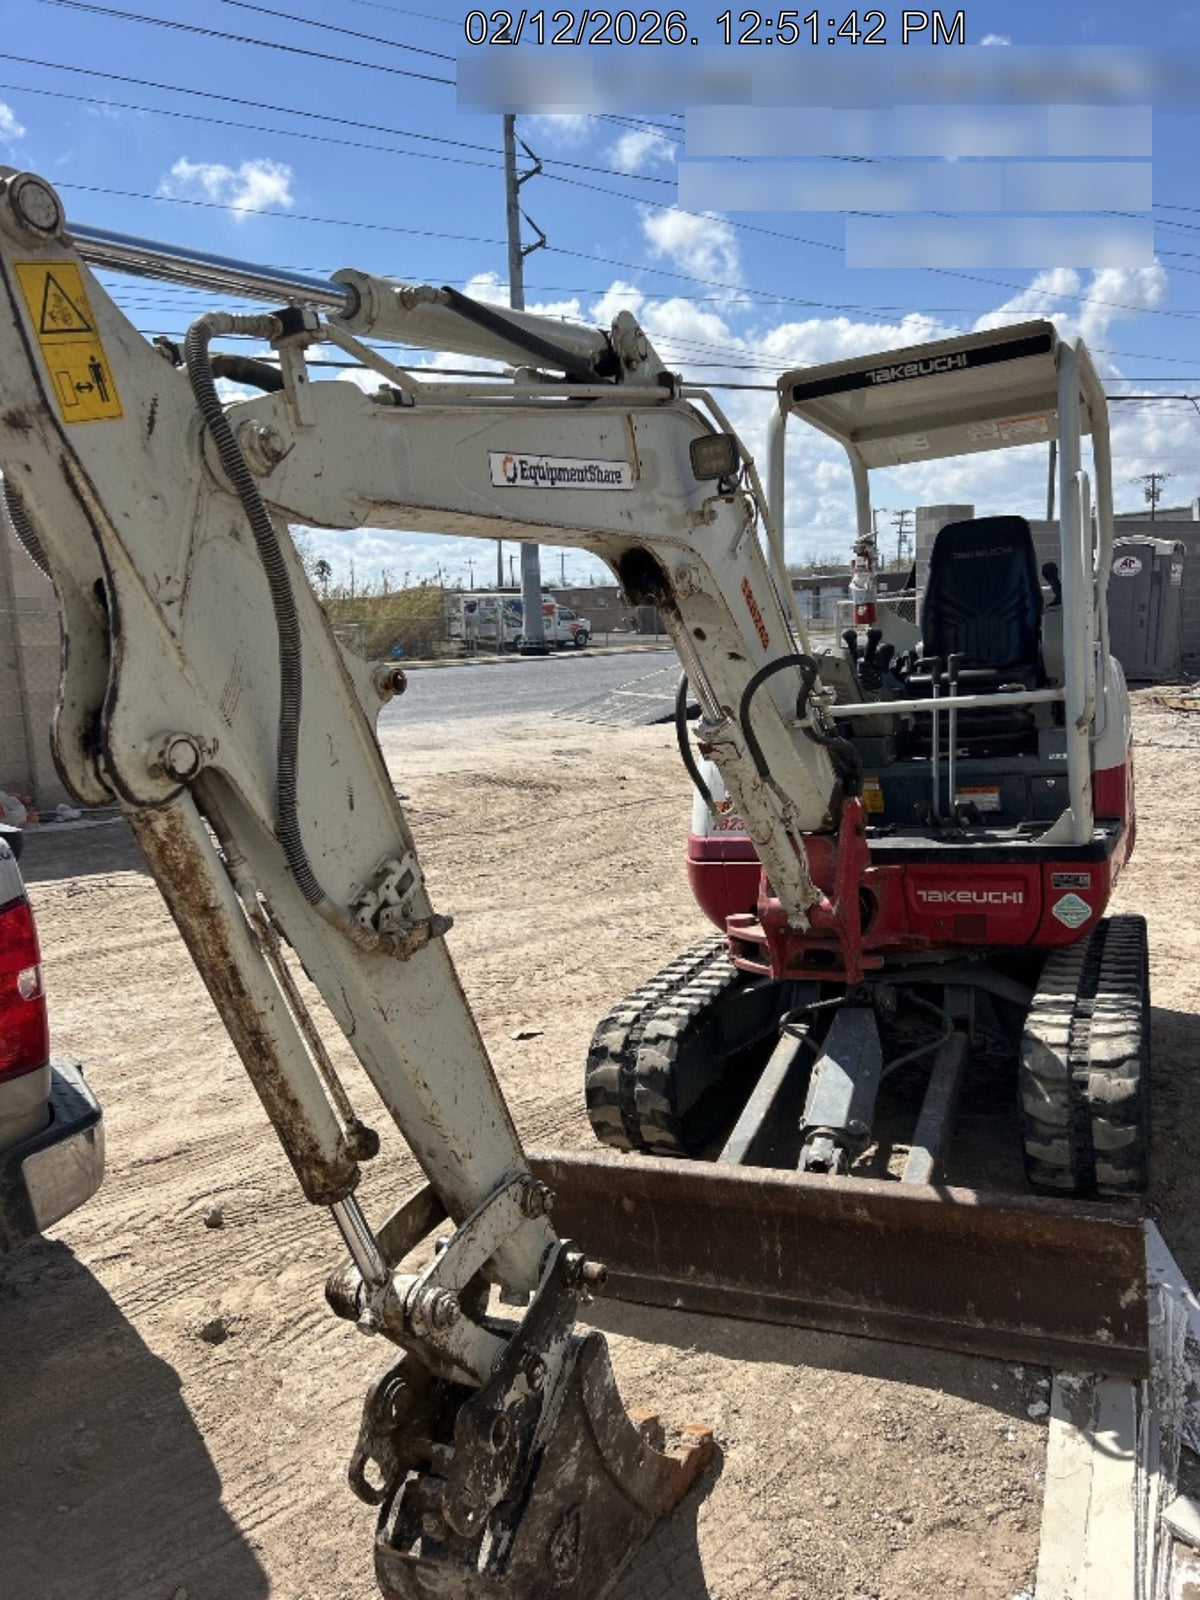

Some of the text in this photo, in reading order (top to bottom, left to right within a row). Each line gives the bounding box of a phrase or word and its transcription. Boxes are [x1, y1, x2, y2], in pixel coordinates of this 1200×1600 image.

[865, 353, 967, 383] TAKEUCHI
[519, 460, 623, 486] EquipmentShare
[916, 890, 1024, 904] TAKEUCHI
